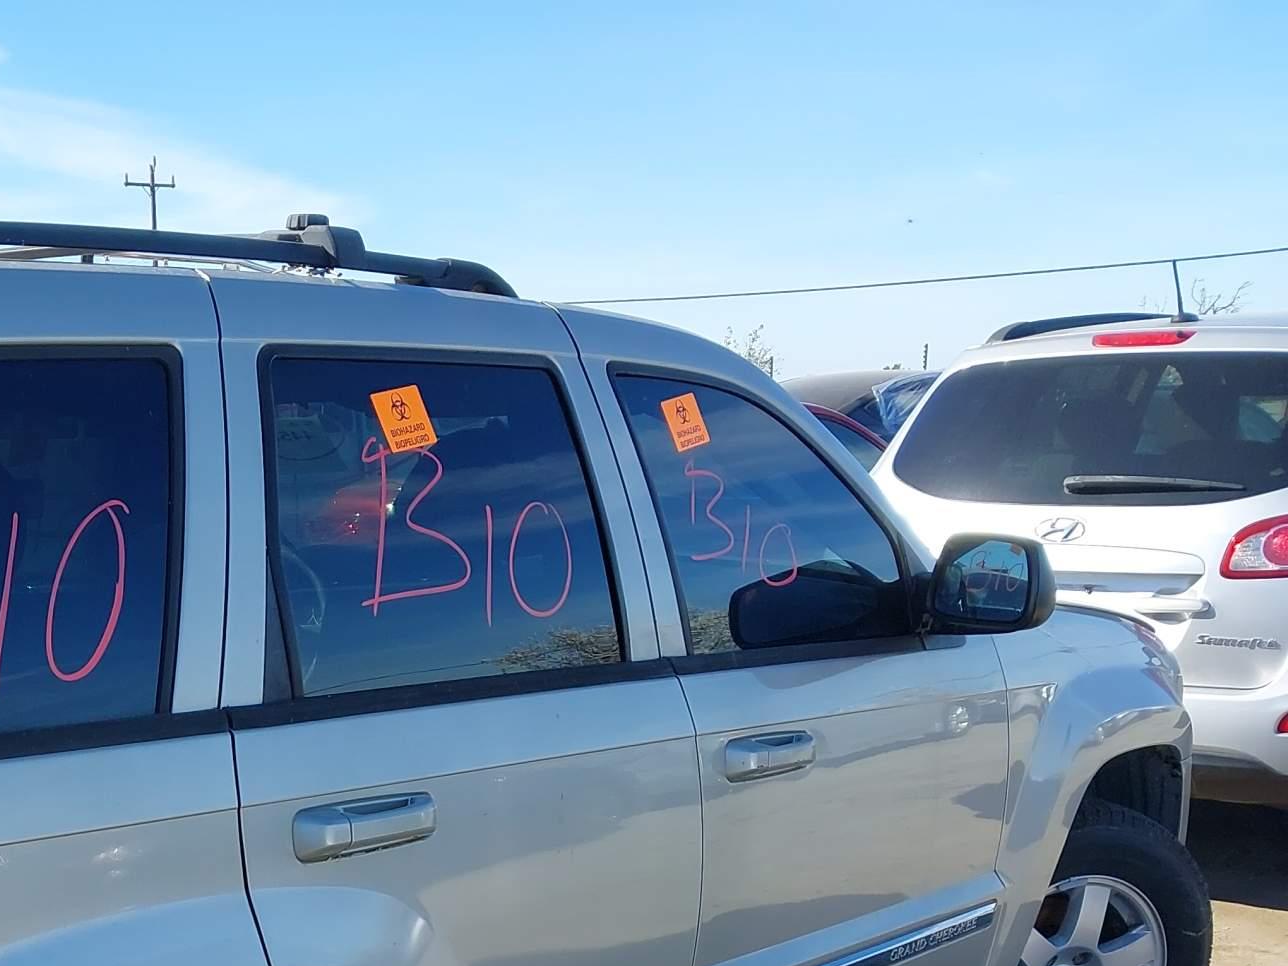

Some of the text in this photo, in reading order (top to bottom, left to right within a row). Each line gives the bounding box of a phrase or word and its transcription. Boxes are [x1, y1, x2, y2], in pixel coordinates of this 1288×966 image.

[390, 422, 426, 438] BIOHAZARD
[395, 433, 430, 449] BIOPELIGRO
[890, 917, 979, 961] GRAND CHEROKEE
